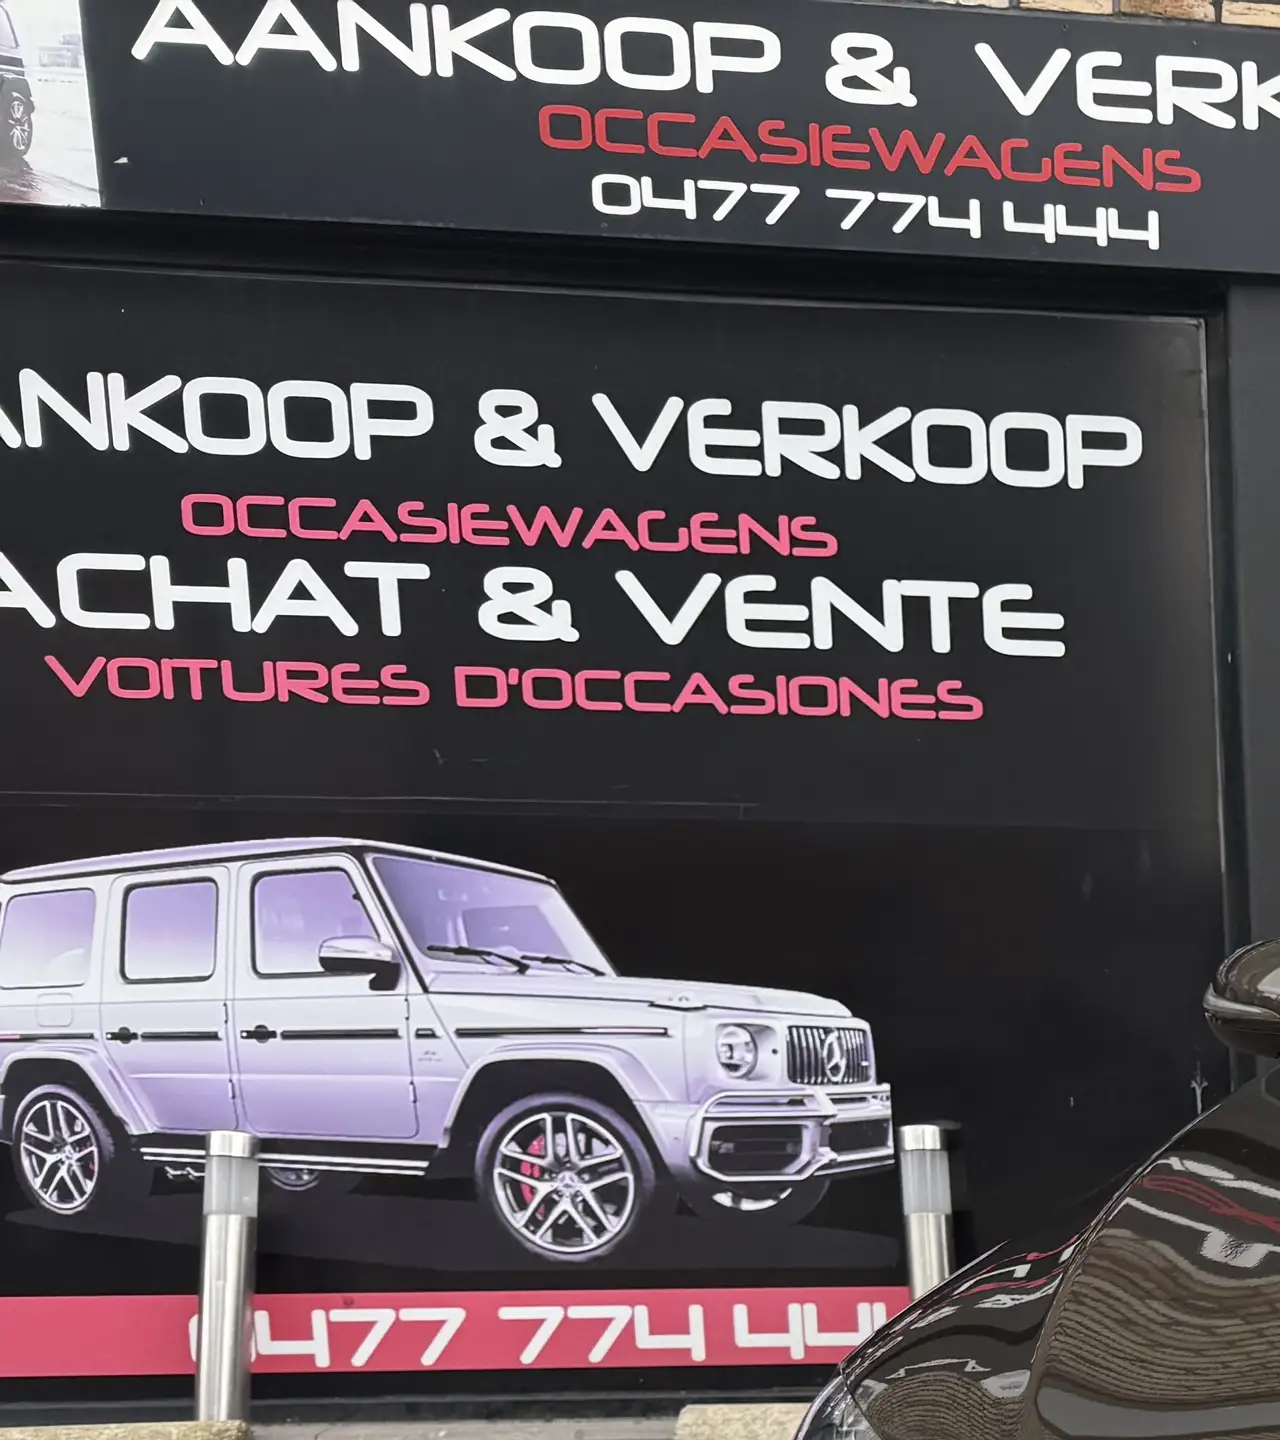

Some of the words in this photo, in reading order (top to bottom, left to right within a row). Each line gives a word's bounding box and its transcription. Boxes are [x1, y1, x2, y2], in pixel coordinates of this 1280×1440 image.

[131, 0, 782, 94] AANKOOP
[825, 32, 918, 108] &
[538, 104, 1202, 193] OCCASIEWAGENS
[591, 173, 801, 225] 0477
[825, 188, 982, 239] 774
[1002, 200, 1160, 251] 444
[473, 388, 562, 468] &
[591, 392, 1143, 490] VERKOOP
[180, 493, 839, 557] OCCASIEWAGENS
[477, 566, 580, 642] &
[614, 569, 1066, 657] VENTE
[44, 655, 431, 706] VOITURES
[454, 666, 984, 721] D'OCCASIONES
[497, 1304, 706, 1365] 774
[732, 1302, 887, 1360] 44
